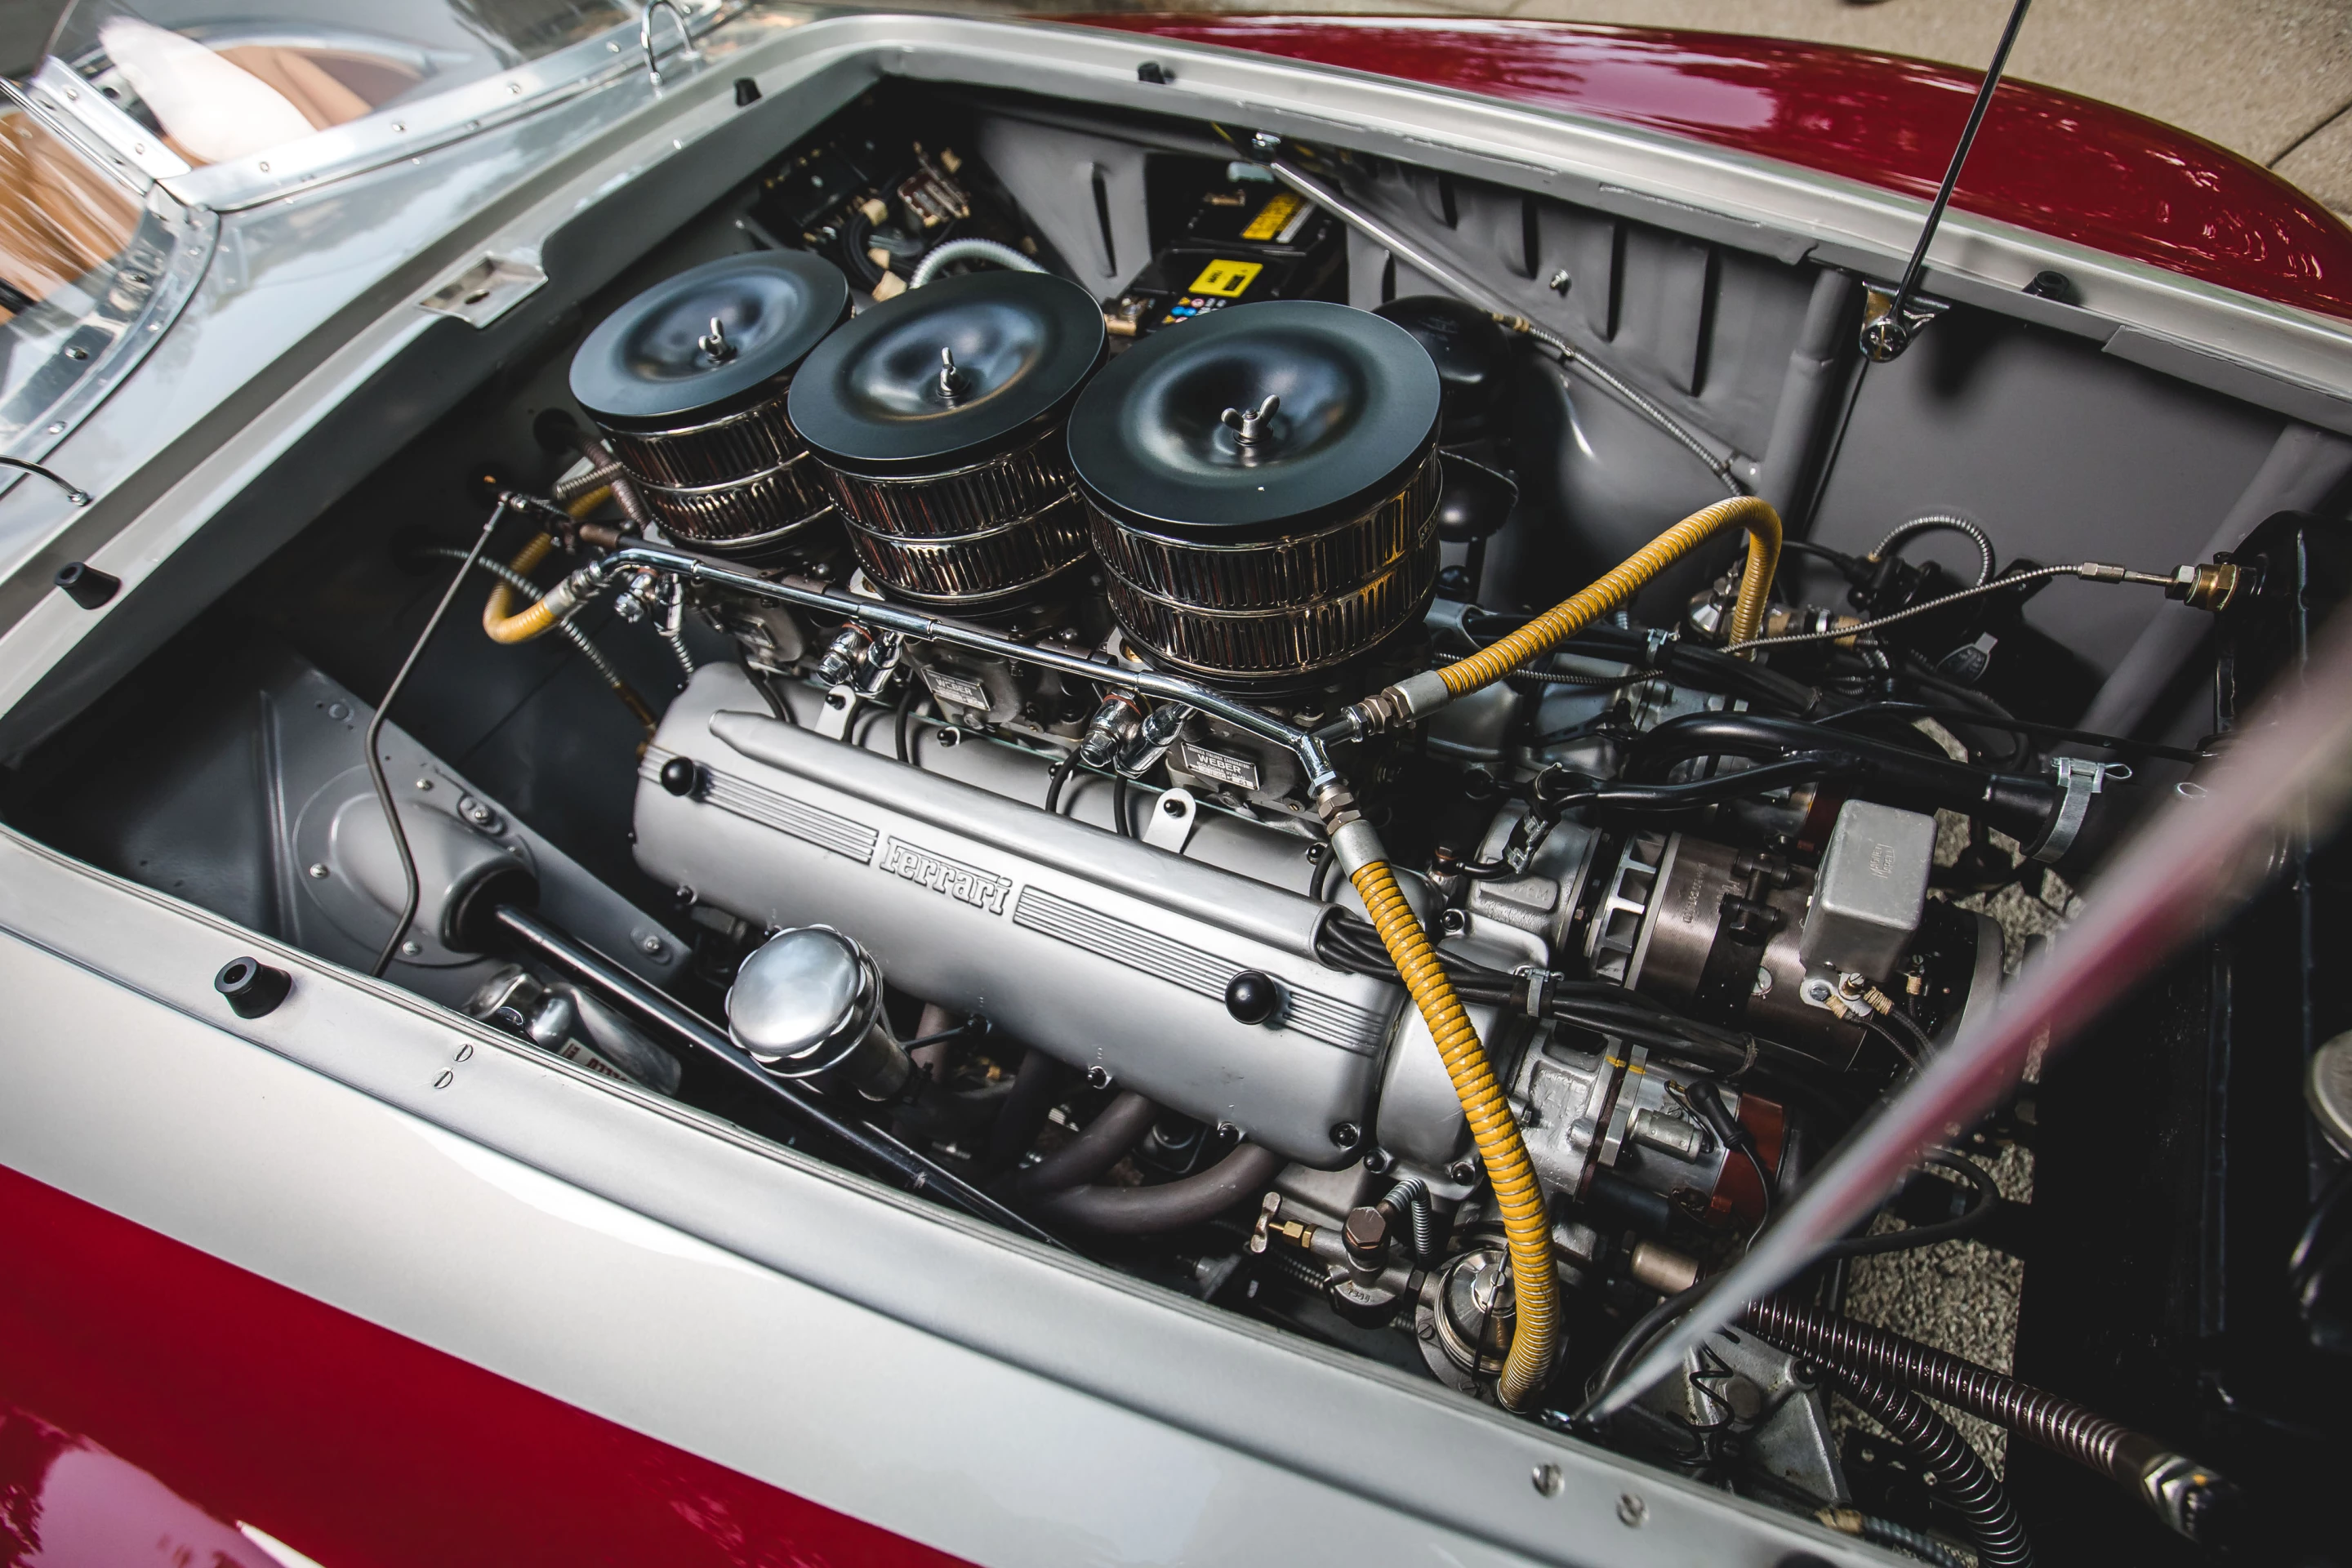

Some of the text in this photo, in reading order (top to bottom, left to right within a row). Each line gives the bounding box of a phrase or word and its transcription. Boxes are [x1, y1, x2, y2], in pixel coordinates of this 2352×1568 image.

[935, 678, 973, 696] WEBER
[1196, 761, 1224, 773] BOLOGNA
[1197, 754, 1241, 774] WEBER
[880, 835, 1013, 915] Ferrari
